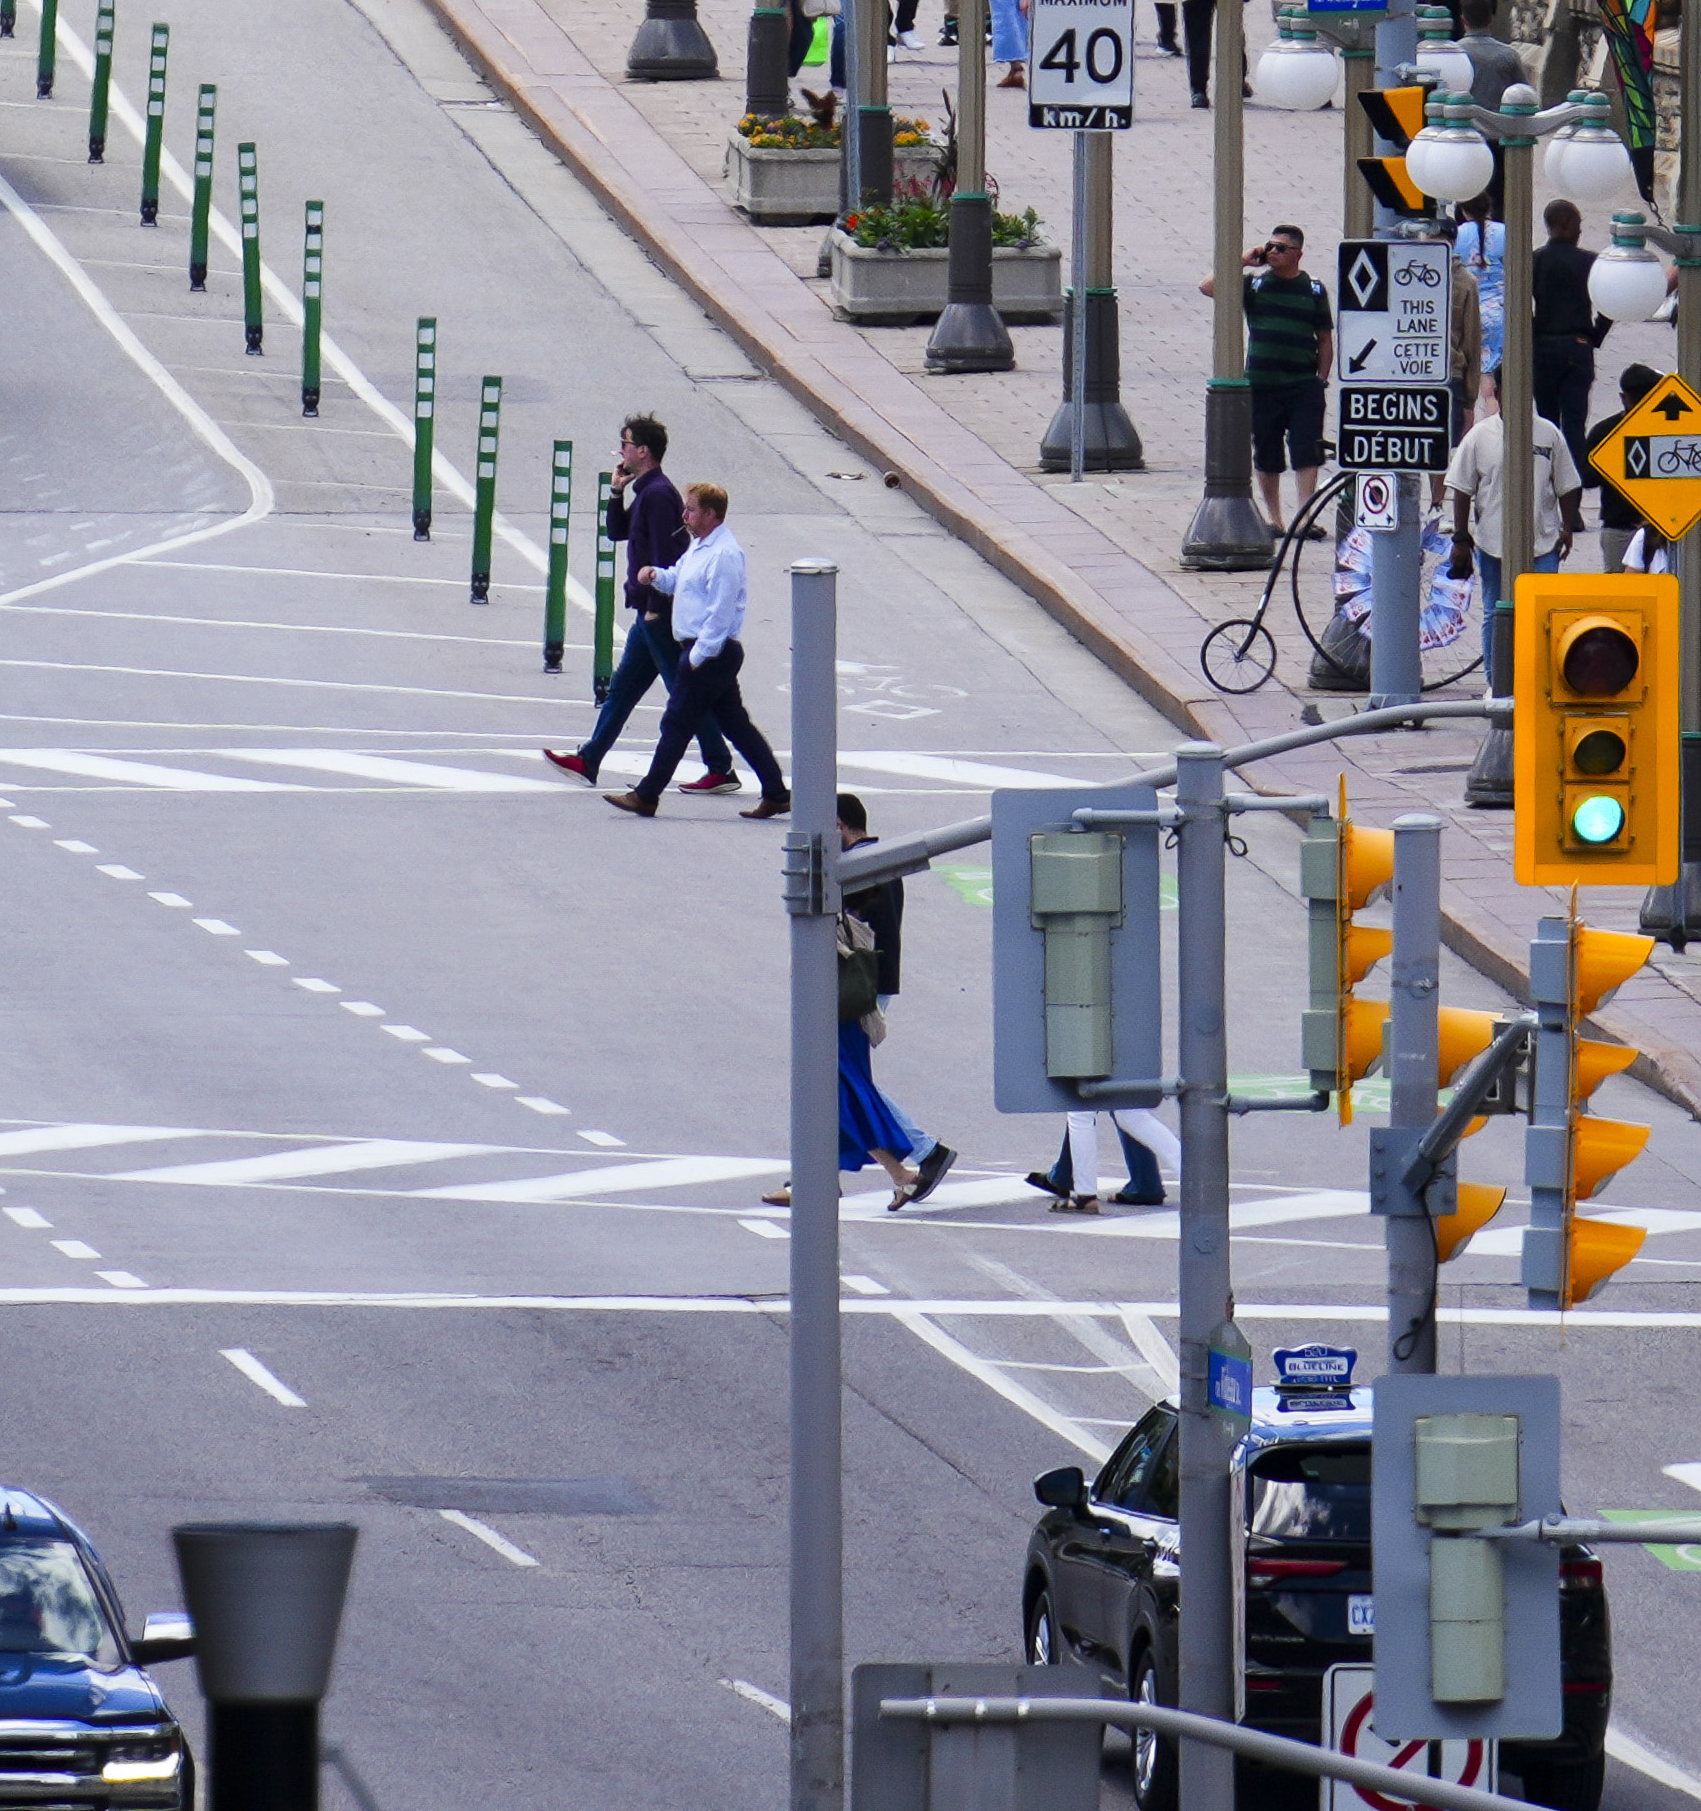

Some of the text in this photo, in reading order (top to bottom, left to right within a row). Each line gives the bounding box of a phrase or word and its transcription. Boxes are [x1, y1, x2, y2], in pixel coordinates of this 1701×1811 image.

[1039, 26, 1123, 84] 40
[1043, 107, 1118, 128] km/h
[1400, 300, 1435, 315] THIS
[1397, 319, 1437, 333] LANE
[1394, 342, 1440, 358] CETTE
[1400, 360, 1433, 375] VOIE
[1350, 393, 1438, 421] BEGINS
[1353, 431, 1434, 464] DÉBUT
